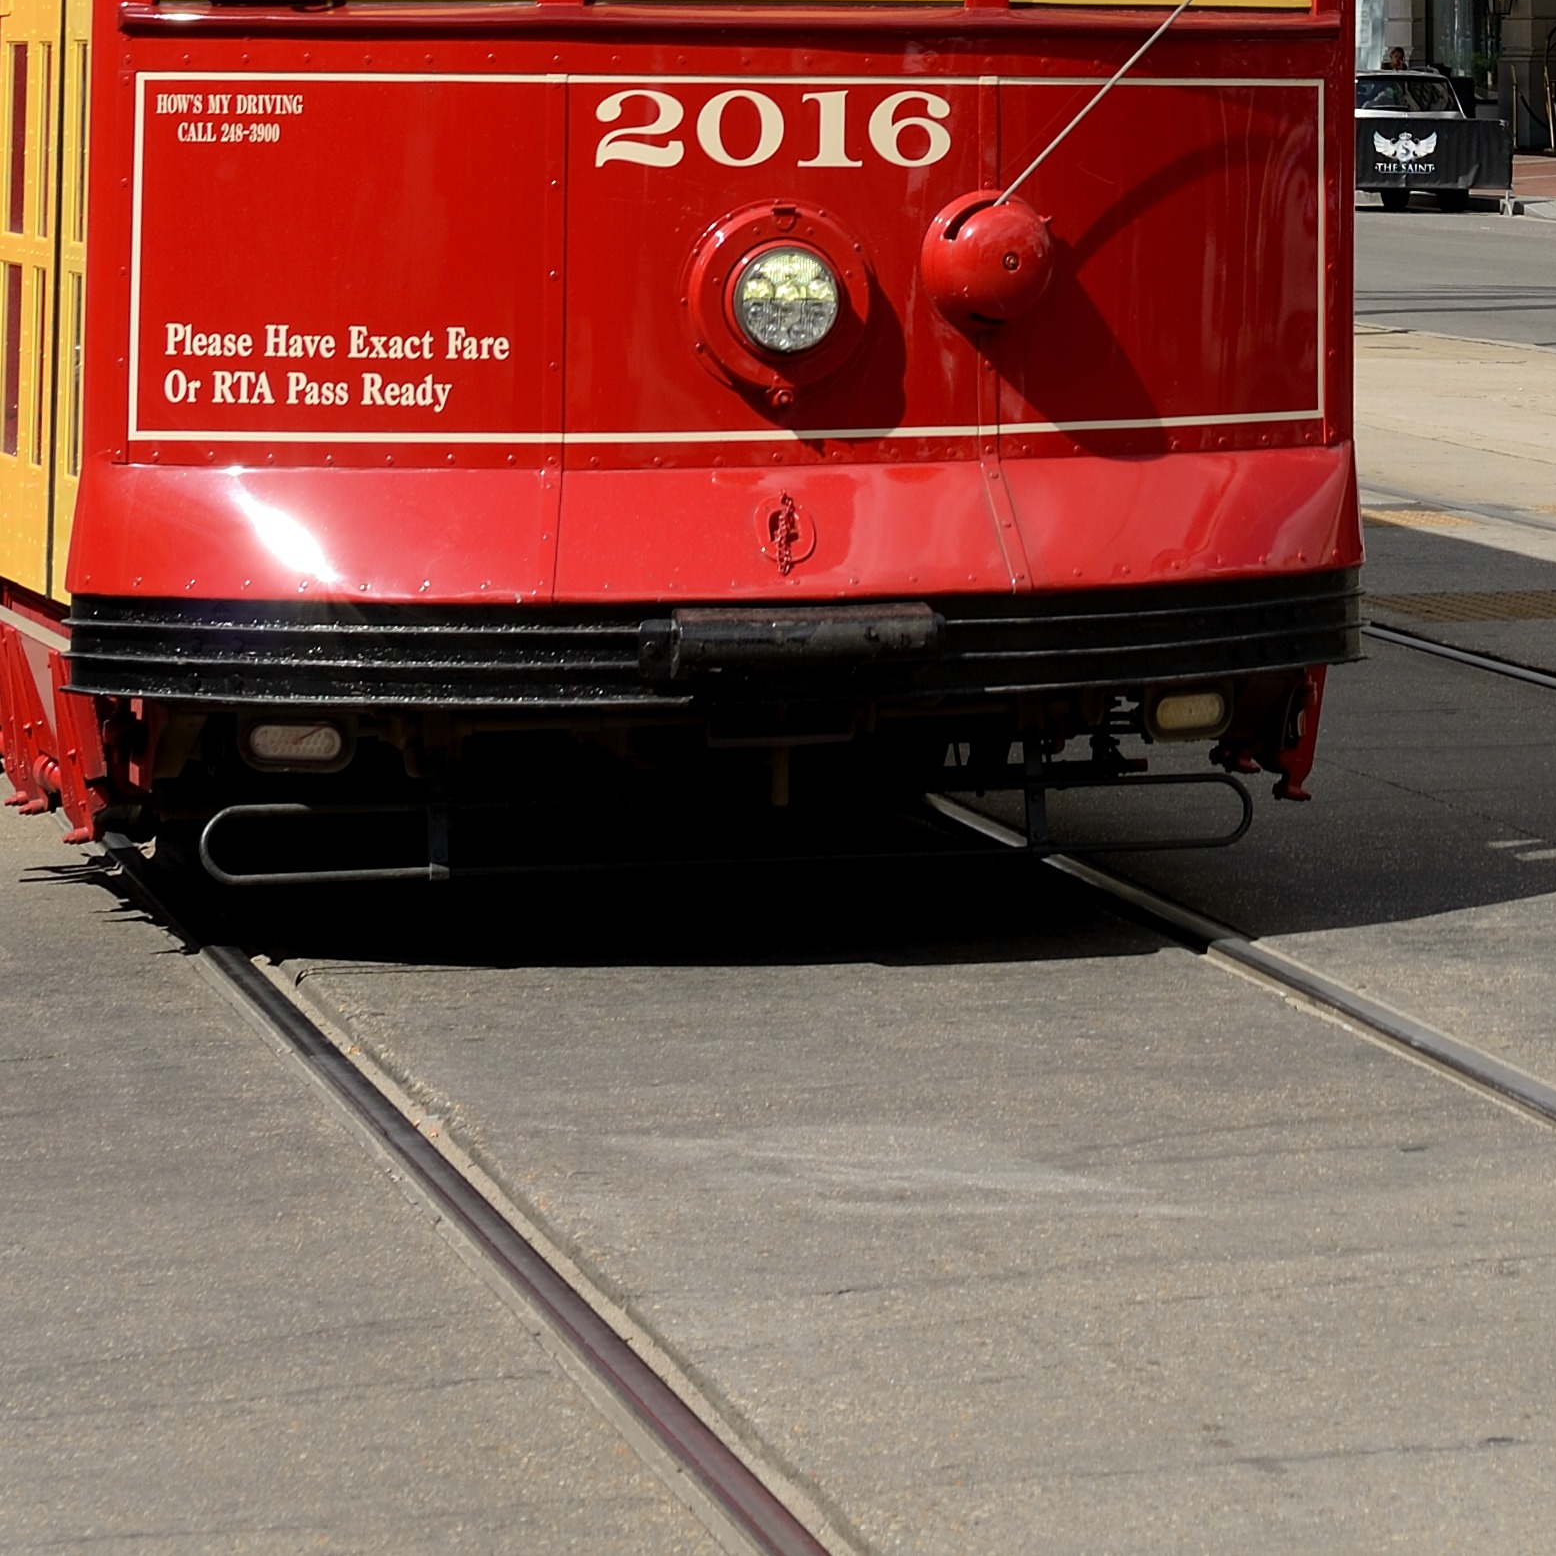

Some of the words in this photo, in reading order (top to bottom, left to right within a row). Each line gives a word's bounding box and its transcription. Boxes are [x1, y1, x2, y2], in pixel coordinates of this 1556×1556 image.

[156, 93, 203, 114] HOW'S
[207, 94, 232, 114] MY
[235, 94, 304, 115] DRIVING
[177, 122, 217, 142] CALL
[220, 123, 280, 143] 248-3900
[593, 89, 953, 168] 2016
[1376, 163, 1398, 173] THE
[1401, 162, 1435, 174] SAINT
[164, 322, 253, 357] Please
[264, 324, 336, 359] Have
[347, 325, 434, 360] Exact
[445, 326, 511, 360] Fare
[164, 369, 201, 404] Or
[211, 370, 275, 405] RTA
[286, 371, 349, 406] Pass
[360, 372, 453, 413] Ready
